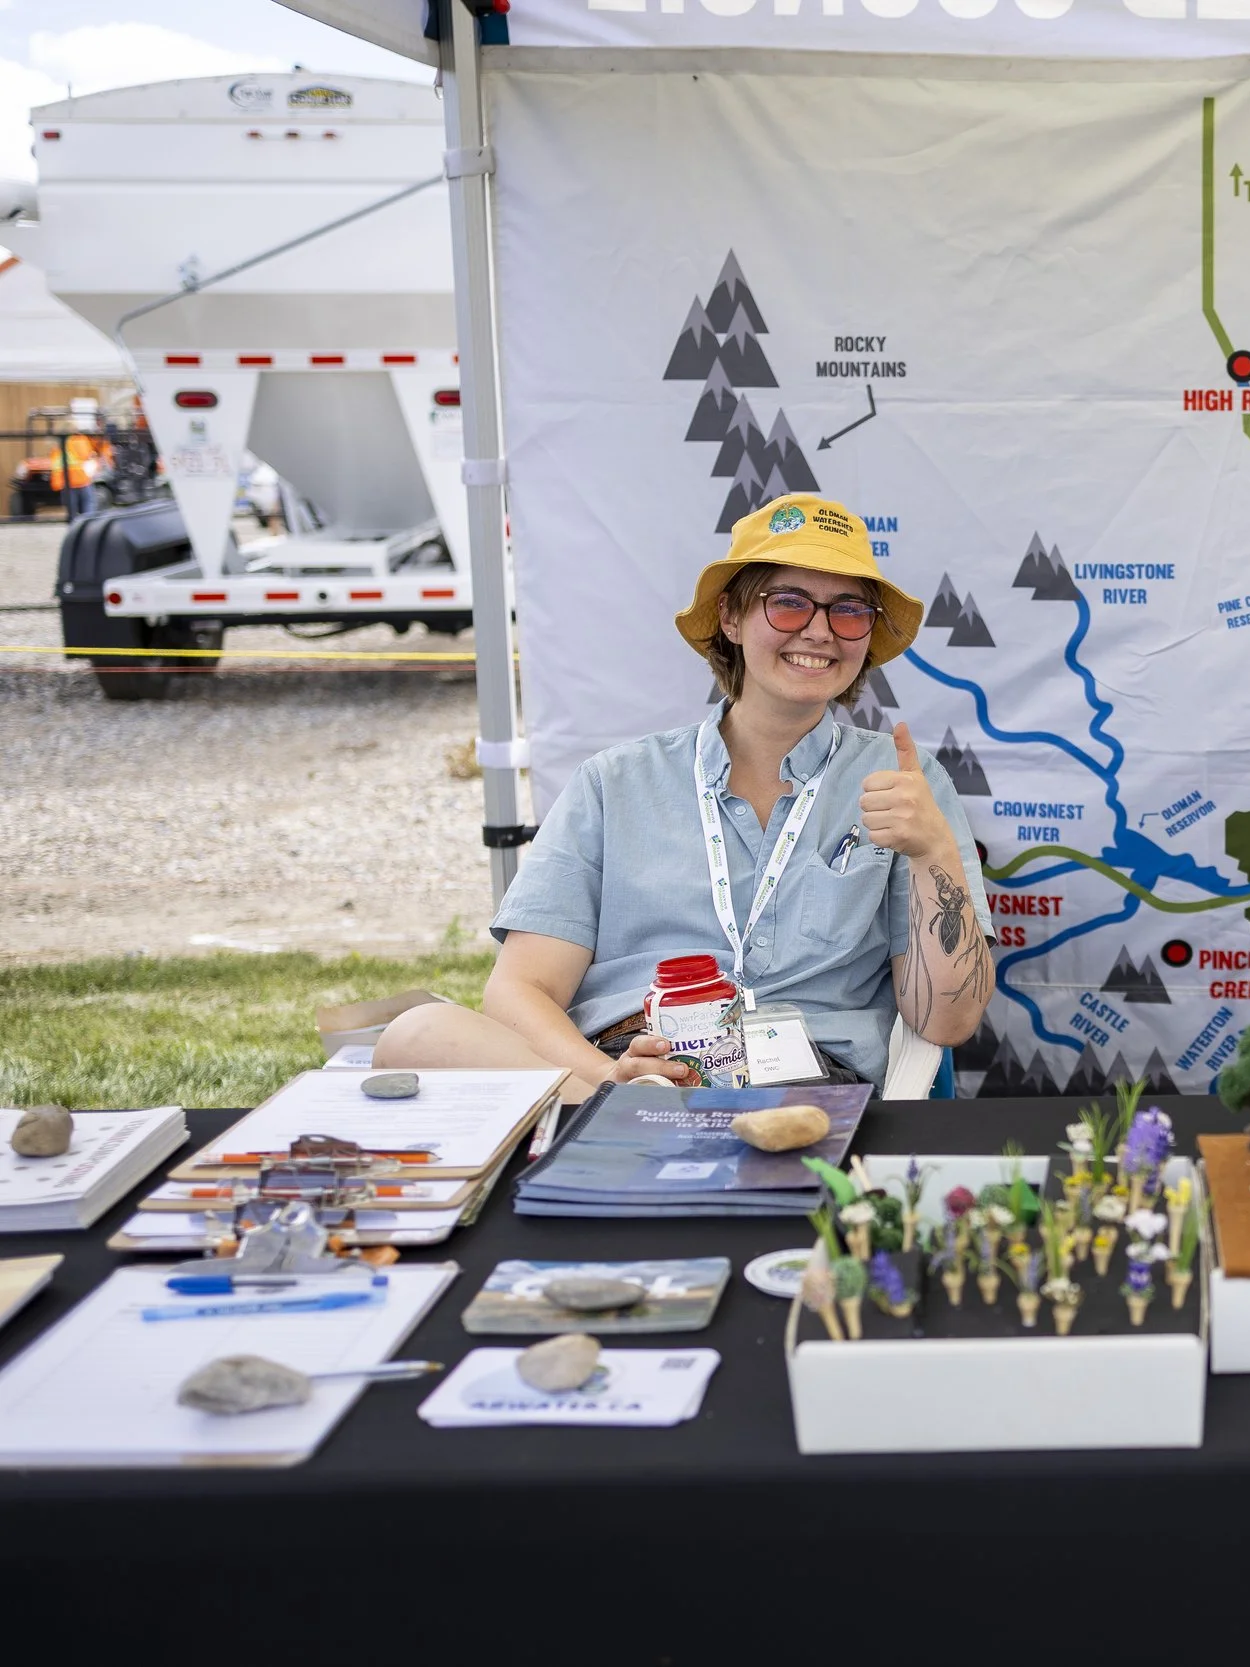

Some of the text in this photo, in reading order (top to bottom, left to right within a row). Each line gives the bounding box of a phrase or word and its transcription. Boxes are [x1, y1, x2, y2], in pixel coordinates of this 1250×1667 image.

[834, 336, 886, 352] ROCKY
[816, 361, 907, 378] MOUNTAINS
[1183, 389, 1233, 411] HIGH
[812, 515, 854, 534] WATERSHED
[818, 508, 849, 523] OLDMAN
[861, 516, 898, 533] MAN
[818, 524, 849, 538] COUNCIL
[1074, 563, 1175, 581] LIVINGSTONE
[1102, 588, 1147, 605] RIVER
[1217, 599, 1242, 615] PINE
[993, 800, 1085, 821] CROWSNEST
[1161, 789, 1202, 820] OLDMAN
[1165, 800, 1217, 838] RESERVOIR
[1017, 825, 1060, 843] RIVER
[986, 893, 1064, 916] SNEST
[1079, 992, 1130, 1034] CASTLE
[1069, 1012, 1110, 1048] RIVER
[1175, 1006, 1234, 1072] WATERTON
[1205, 1034, 1239, 1072] RIVER
